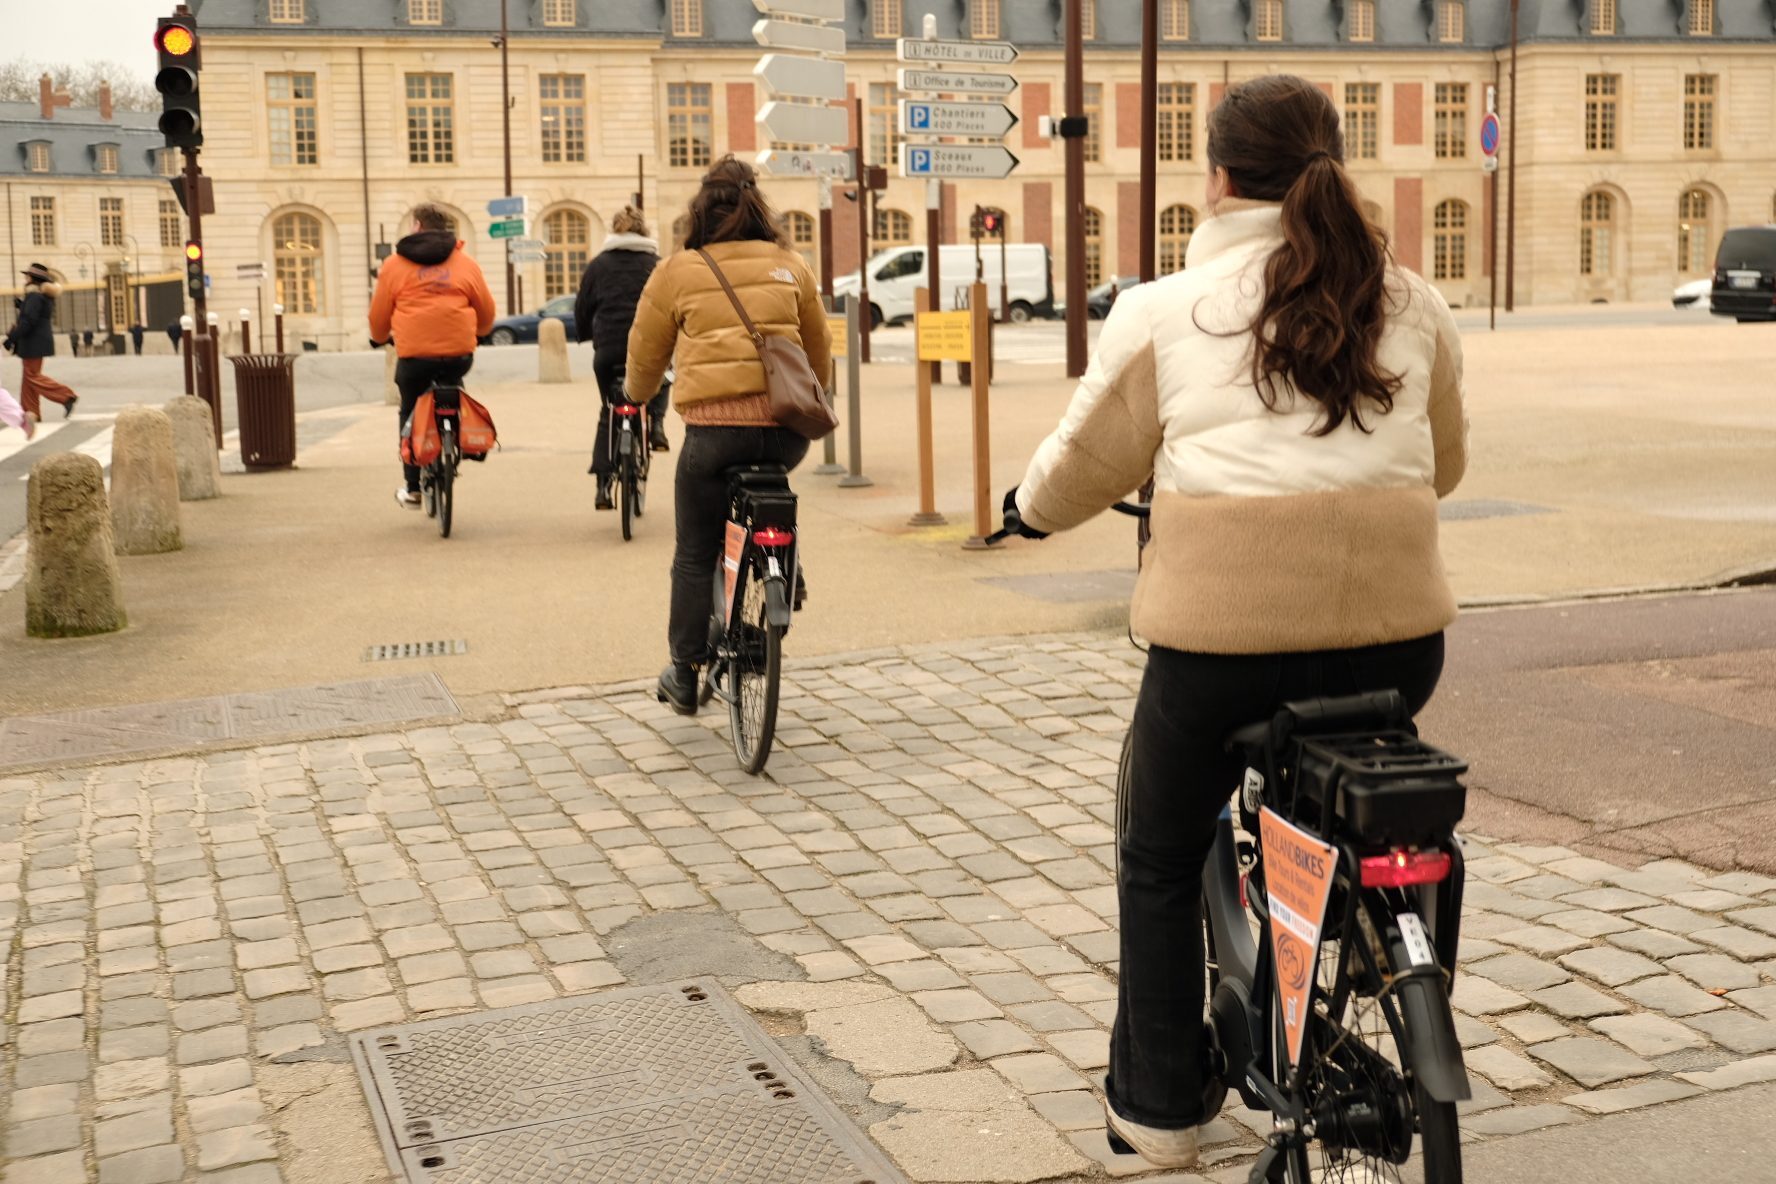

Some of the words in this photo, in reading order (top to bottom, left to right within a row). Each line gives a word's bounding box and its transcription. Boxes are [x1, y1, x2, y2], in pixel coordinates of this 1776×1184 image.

[924, 44, 957, 57] HÔTEL
[978, 48, 1006, 59] VILLE
[924, 76, 949, 86] Office
[955, 78, 965, 87] de
[970, 78, 1005, 88] Tourisme
[933, 107, 985, 119] Chantiers
[956, 121, 985, 130] Places
[934, 151, 972, 162] Sceaux
